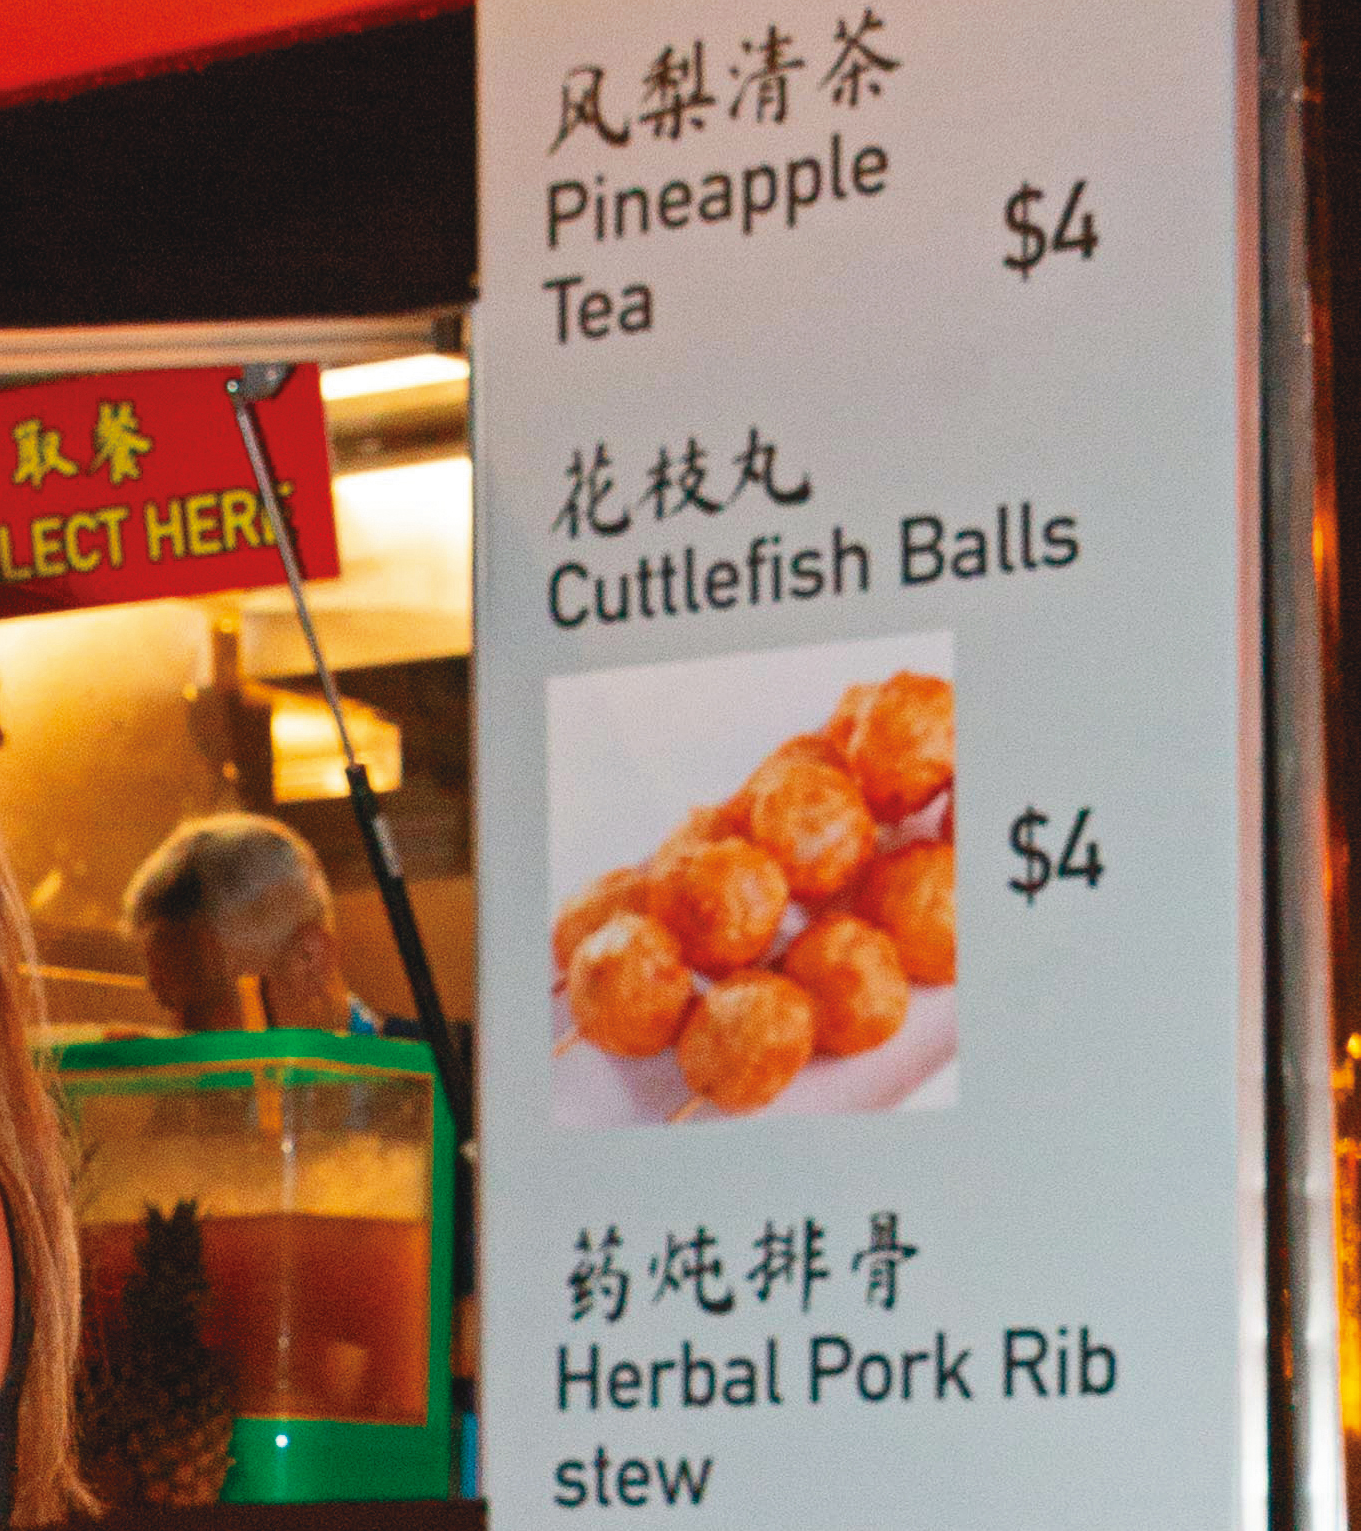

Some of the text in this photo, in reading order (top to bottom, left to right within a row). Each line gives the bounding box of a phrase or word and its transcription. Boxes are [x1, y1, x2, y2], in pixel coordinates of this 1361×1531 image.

[547, 6, 903, 157] 凤梨清茶
[546, 134, 890, 250] Pineapple
[1002, 178, 1101, 281] $4
[541, 274, 654, 345] Tea
[550, 426, 813, 542] 花枝丸
[547, 500, 1081, 629] Cuttlefish Balls
[1007, 805, 1106, 906] $4
[566, 1211, 920, 1325] 药炖排骨
[556, 1325, 1119, 1412] Herbal Pork Rib
[553, 1445, 714, 1511] stew
